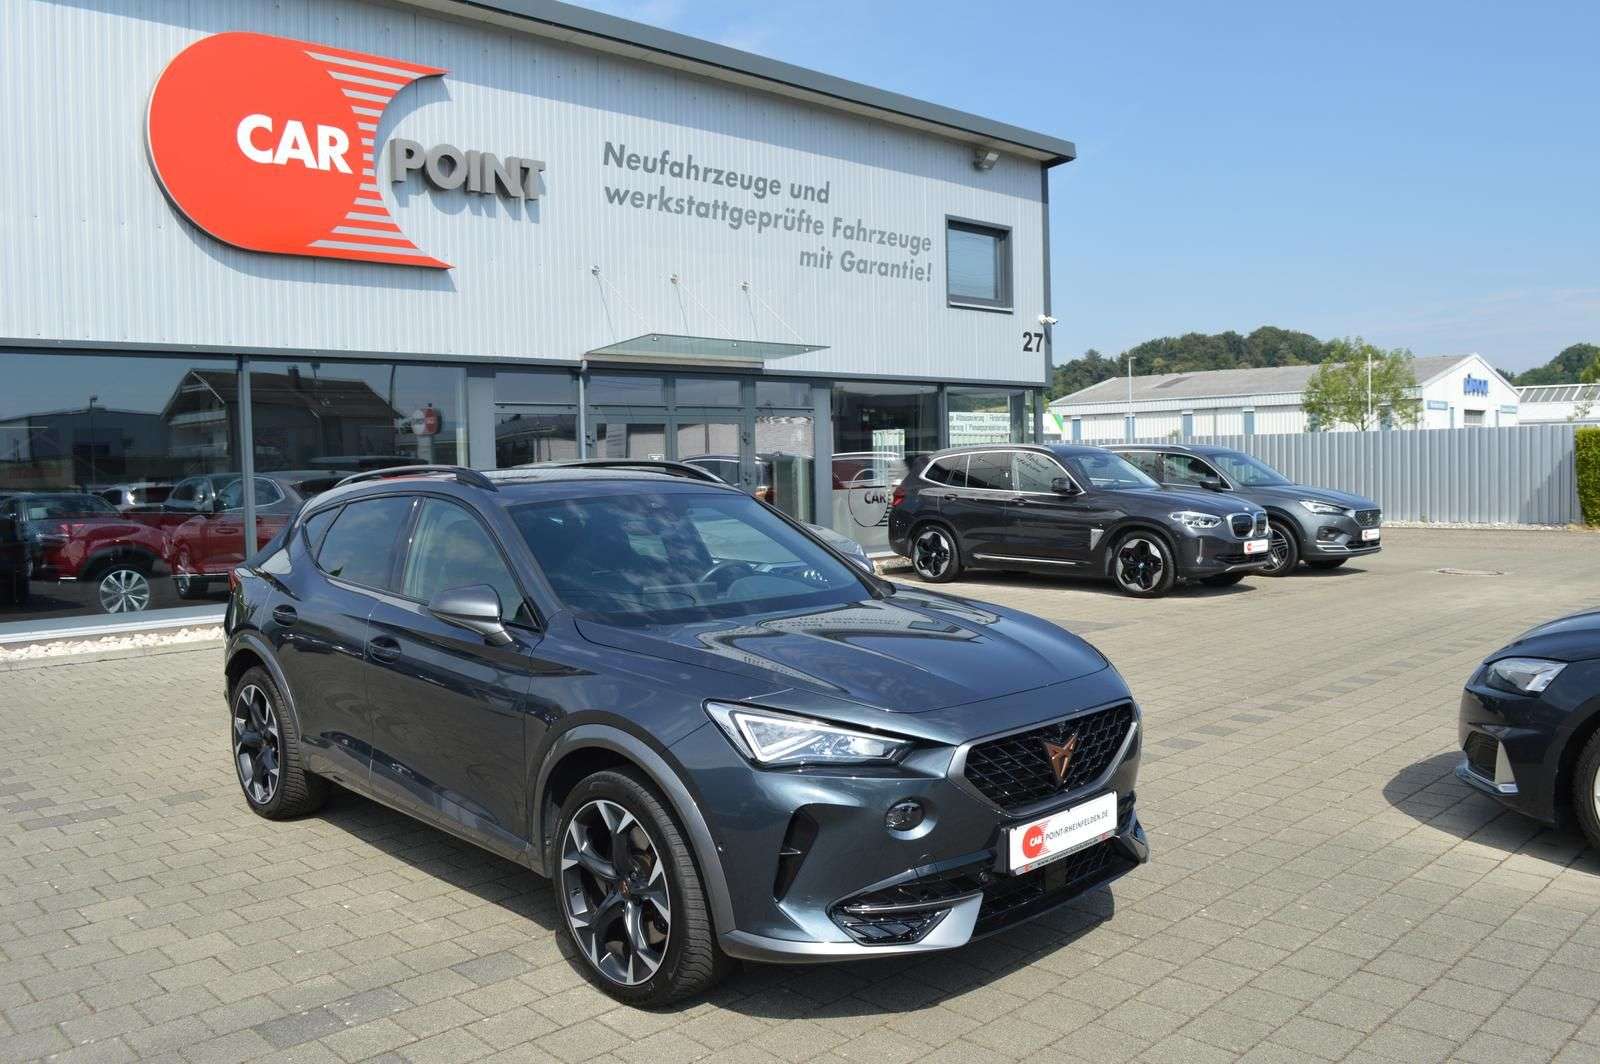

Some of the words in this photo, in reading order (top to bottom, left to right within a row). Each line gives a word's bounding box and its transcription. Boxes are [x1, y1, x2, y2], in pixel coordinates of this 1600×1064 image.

[236, 113, 353, 174] CAR
[390, 138, 546, 201] POINT
[603, 141, 782, 199] Neufahrzeuge
[790, 181, 831, 204] und
[604, 185, 824, 235] werkstattgeprüfte
[832, 217, 932, 256] Fahrzeuge
[800, 246, 832, 270] mit
[840, 250, 932, 283] Garantie!
[1022, 331, 1044, 353] 27
